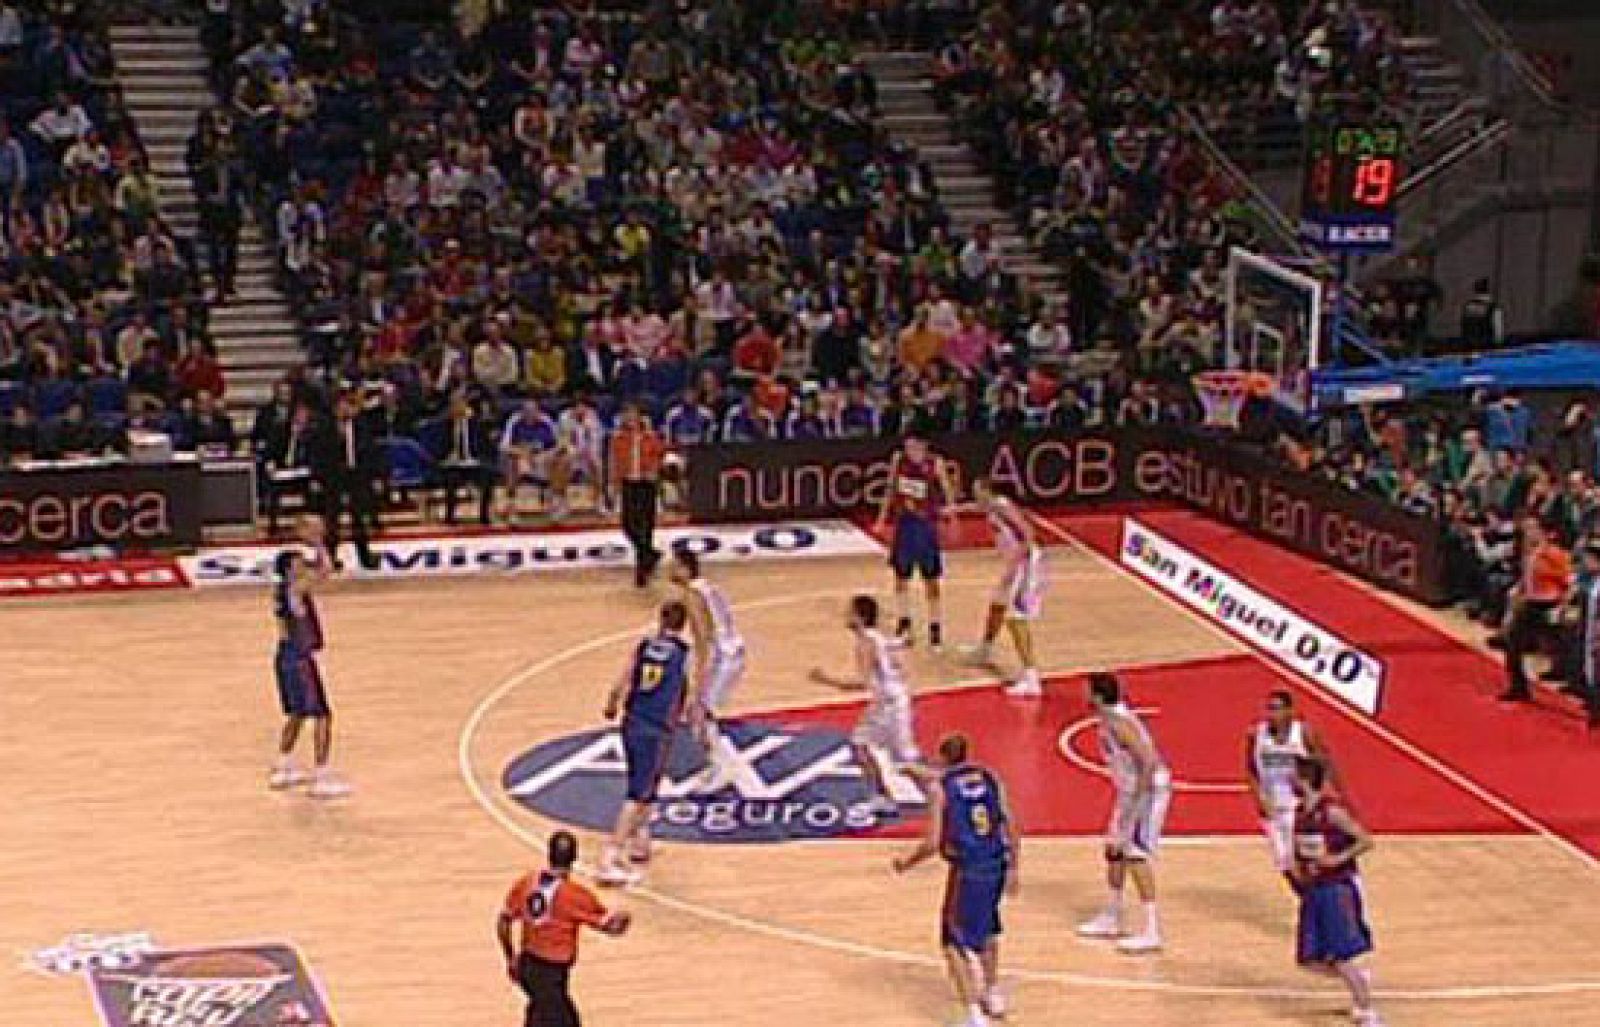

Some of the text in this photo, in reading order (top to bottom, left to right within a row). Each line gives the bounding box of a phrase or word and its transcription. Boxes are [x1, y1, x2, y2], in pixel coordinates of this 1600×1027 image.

[1353, 158, 1391, 204] 19
[0, 490, 170, 543] cerca
[988, 440, 1115, 498] ACB
[1134, 451, 1250, 522] estuvo
[1260, 478, 1311, 543] tan
[1321, 511, 1418, 586] cerca
[1125, 532, 1179, 578] San
[1183, 567, 1291, 643] Miguel
